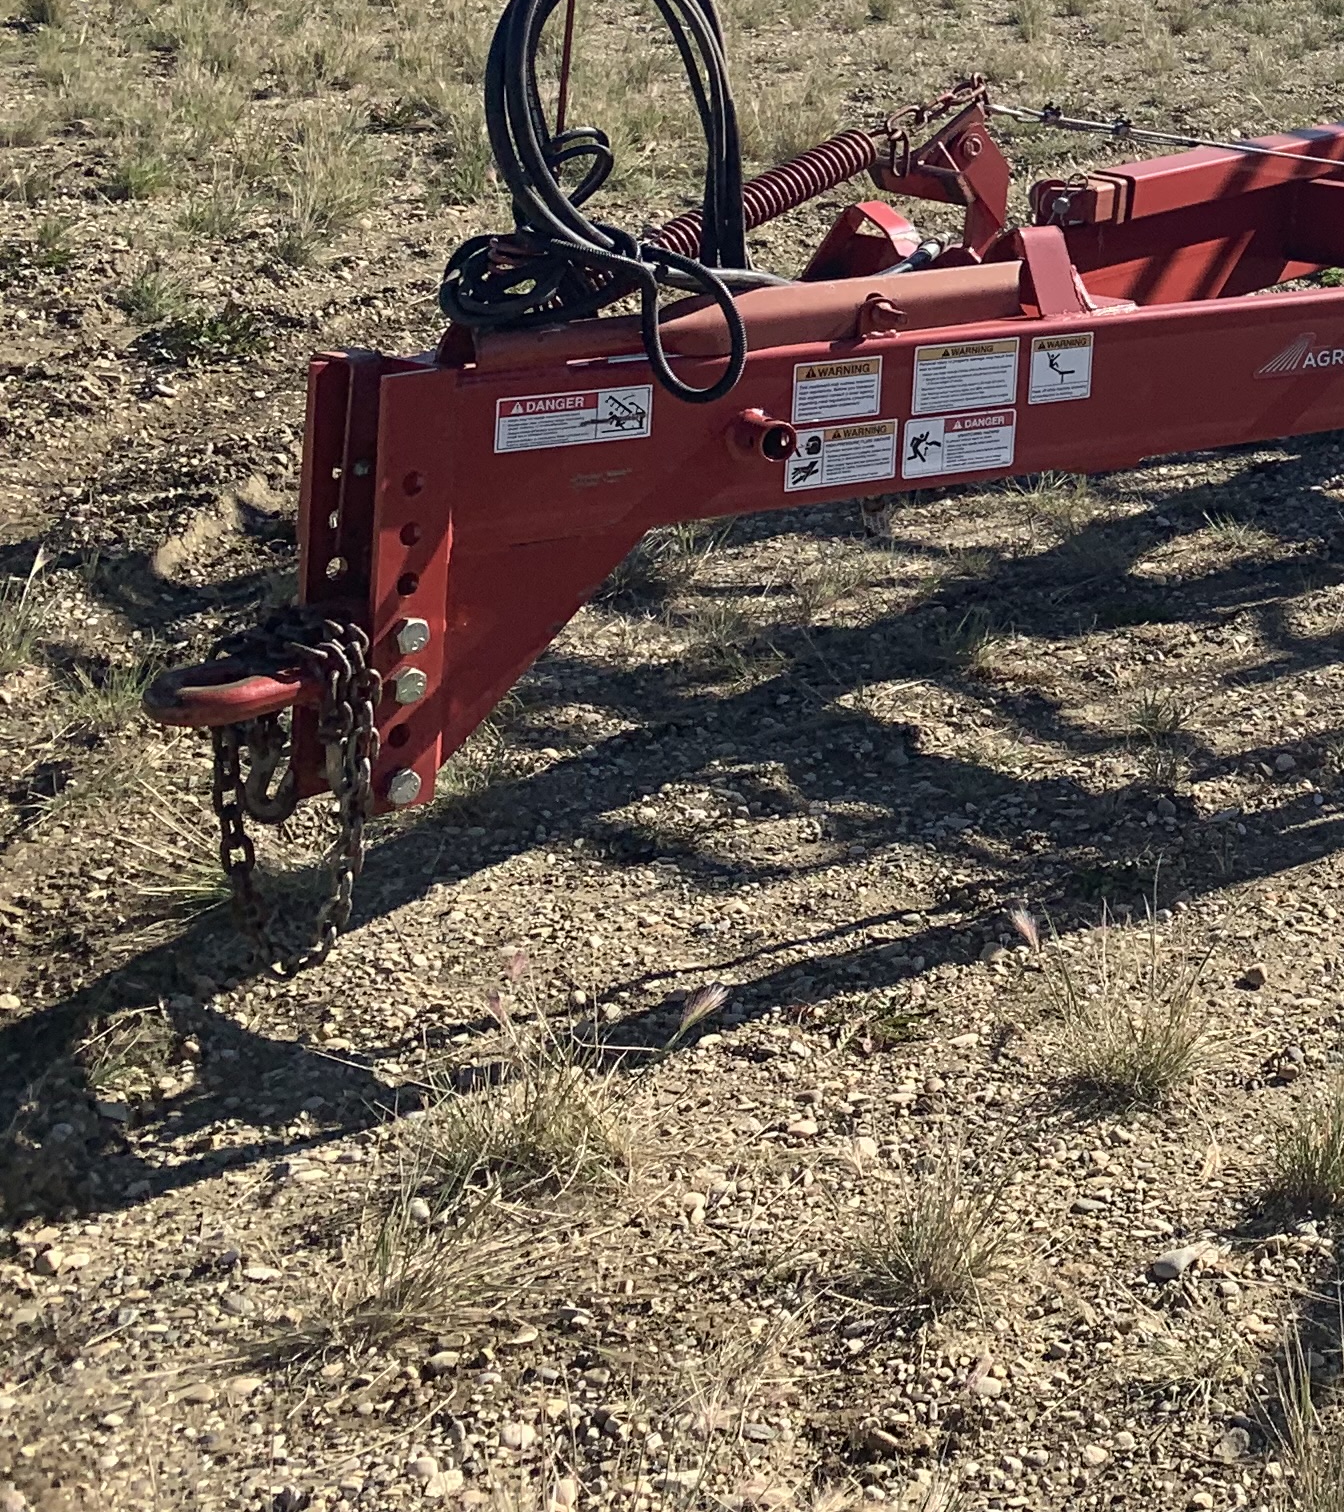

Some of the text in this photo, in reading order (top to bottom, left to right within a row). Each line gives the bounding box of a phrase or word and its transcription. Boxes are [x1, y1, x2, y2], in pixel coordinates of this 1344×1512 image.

[1045, 337, 1088, 349] WARNING
[950, 345, 994, 356] WARNING
[817, 363, 870, 377] WARNING
[526, 396, 585, 413] DANGER
[964, 415, 1005, 430] DANGER
[843, 424, 887, 439] WARNING
